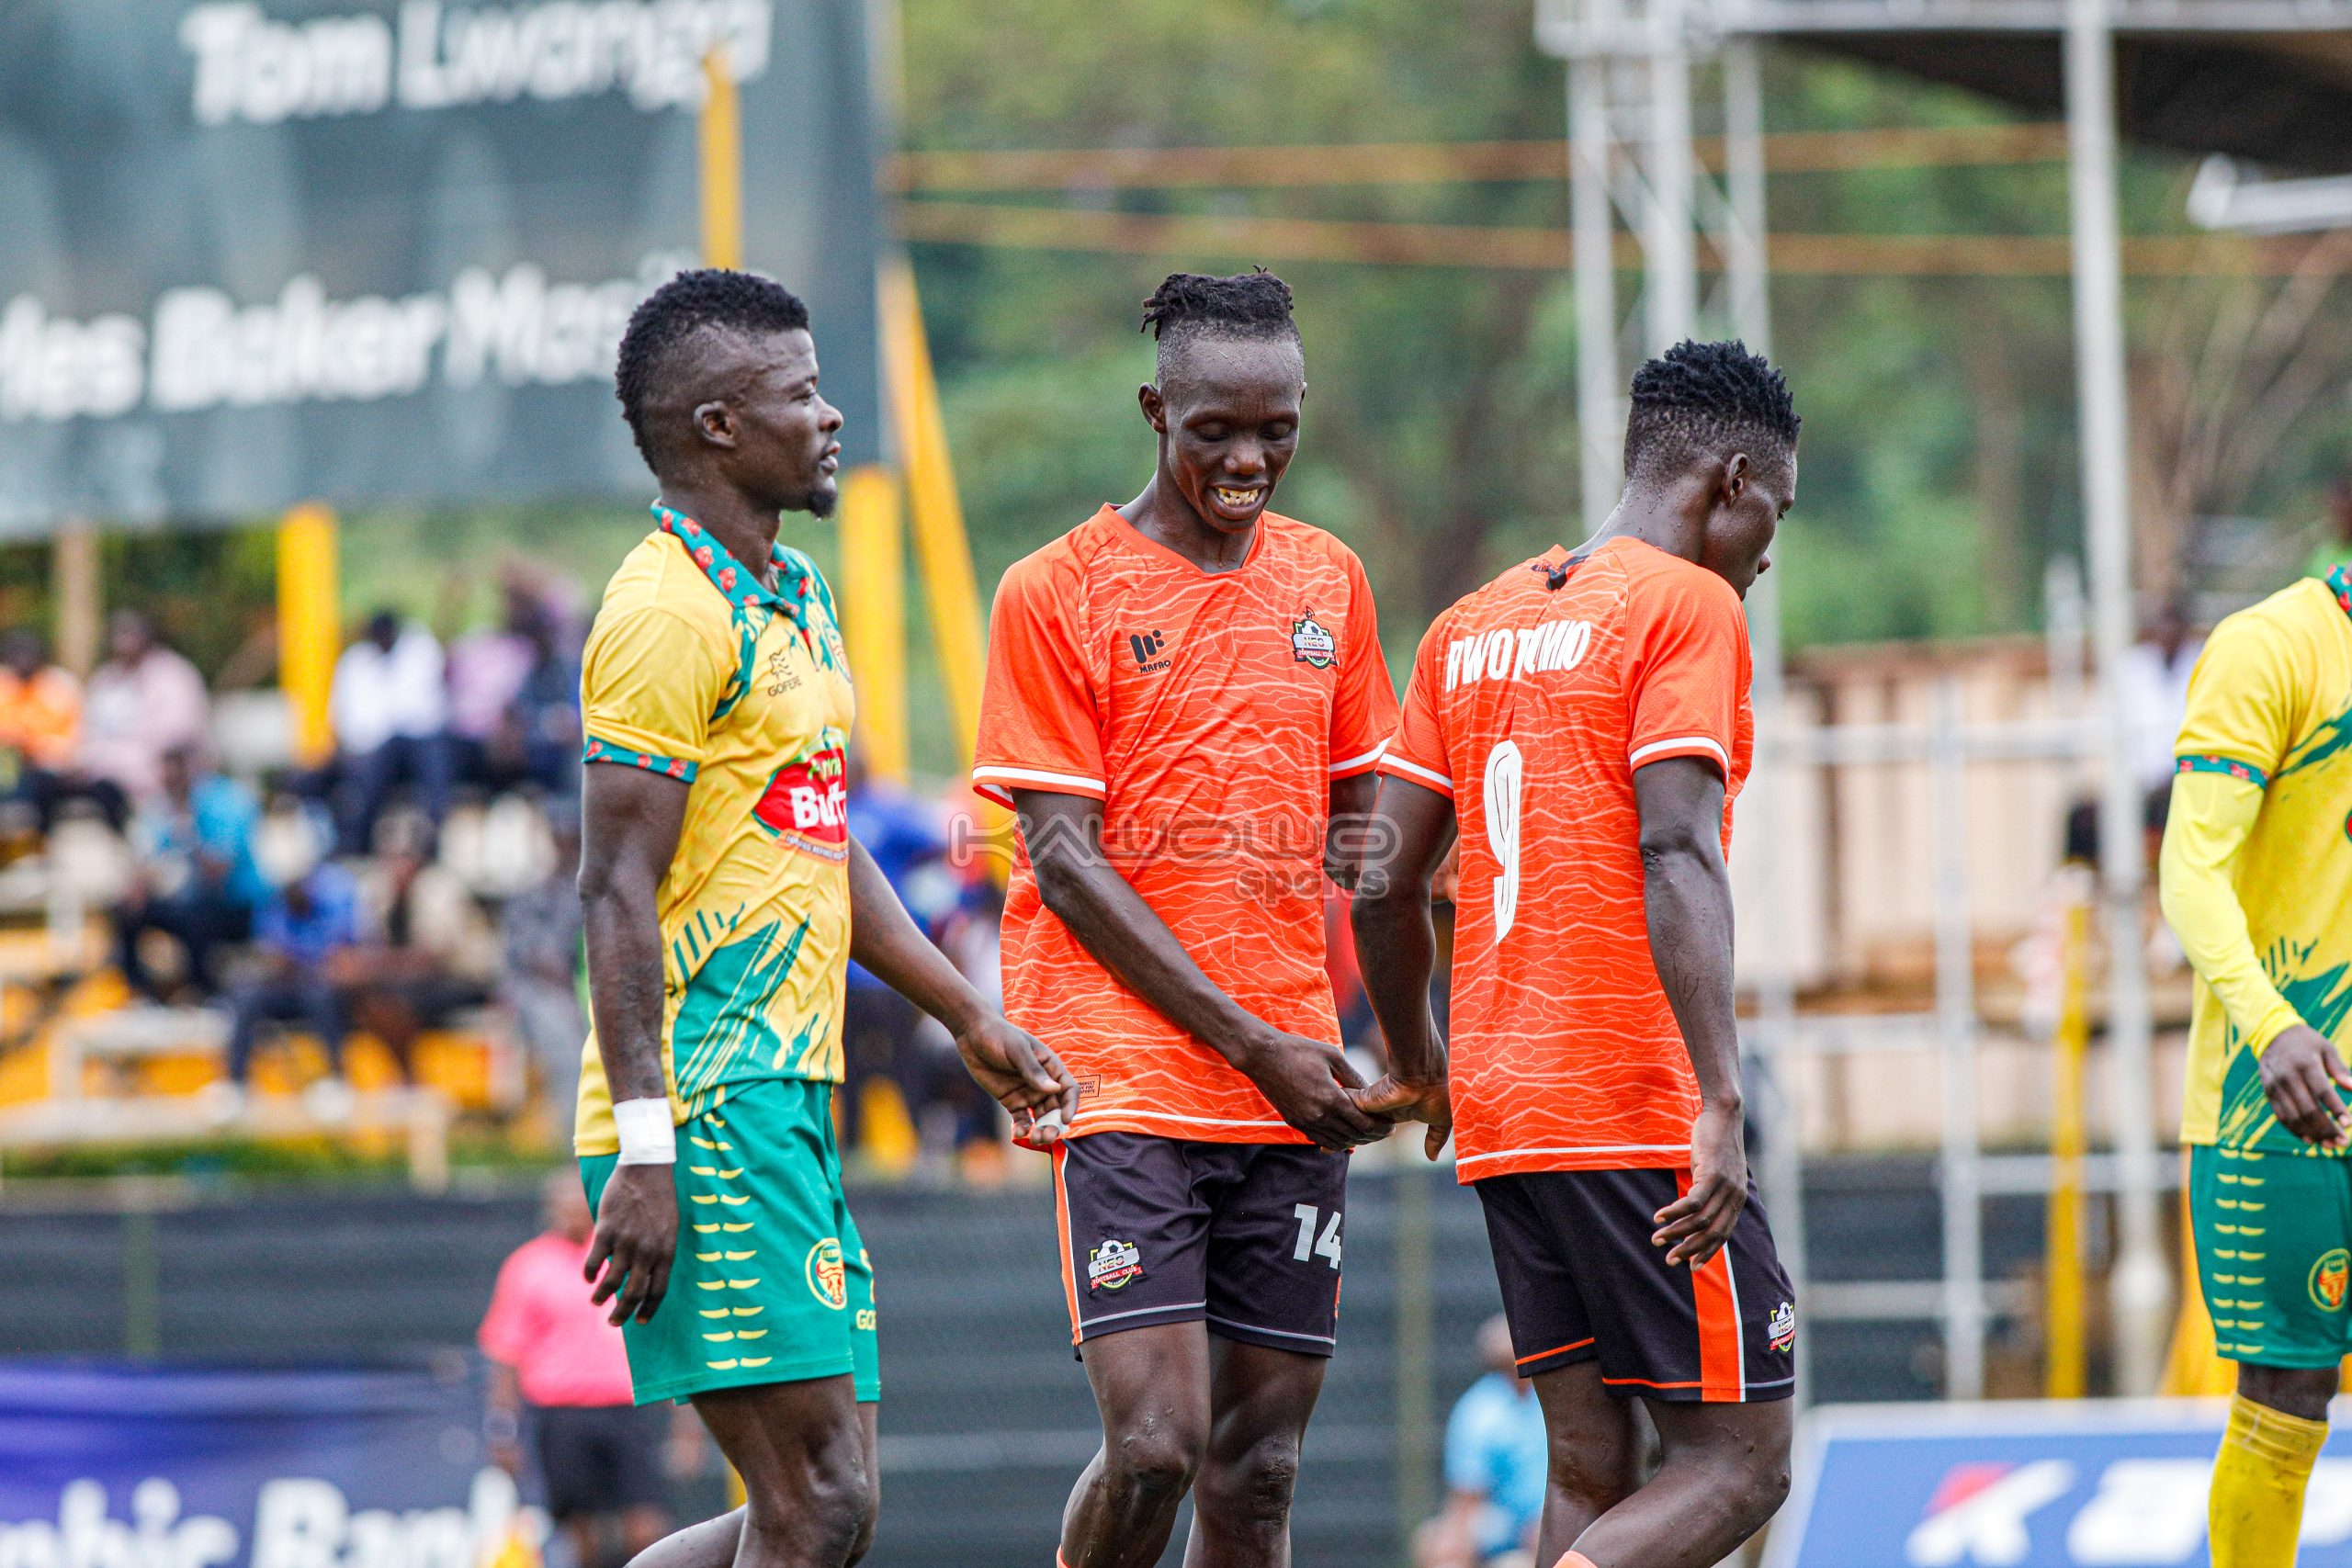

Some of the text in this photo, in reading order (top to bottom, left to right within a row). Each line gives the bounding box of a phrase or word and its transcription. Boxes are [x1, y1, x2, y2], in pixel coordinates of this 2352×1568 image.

[182, 4, 392, 125] Tom
[1139, 660, 1170, 673] MAFRO
[1483, 739, 1522, 944] 9
[1294, 1203, 1341, 1269] 14
[1092, 1271, 1121, 1285] FOOTBALL
[1122, 1266, 1137, 1275] CLUB
